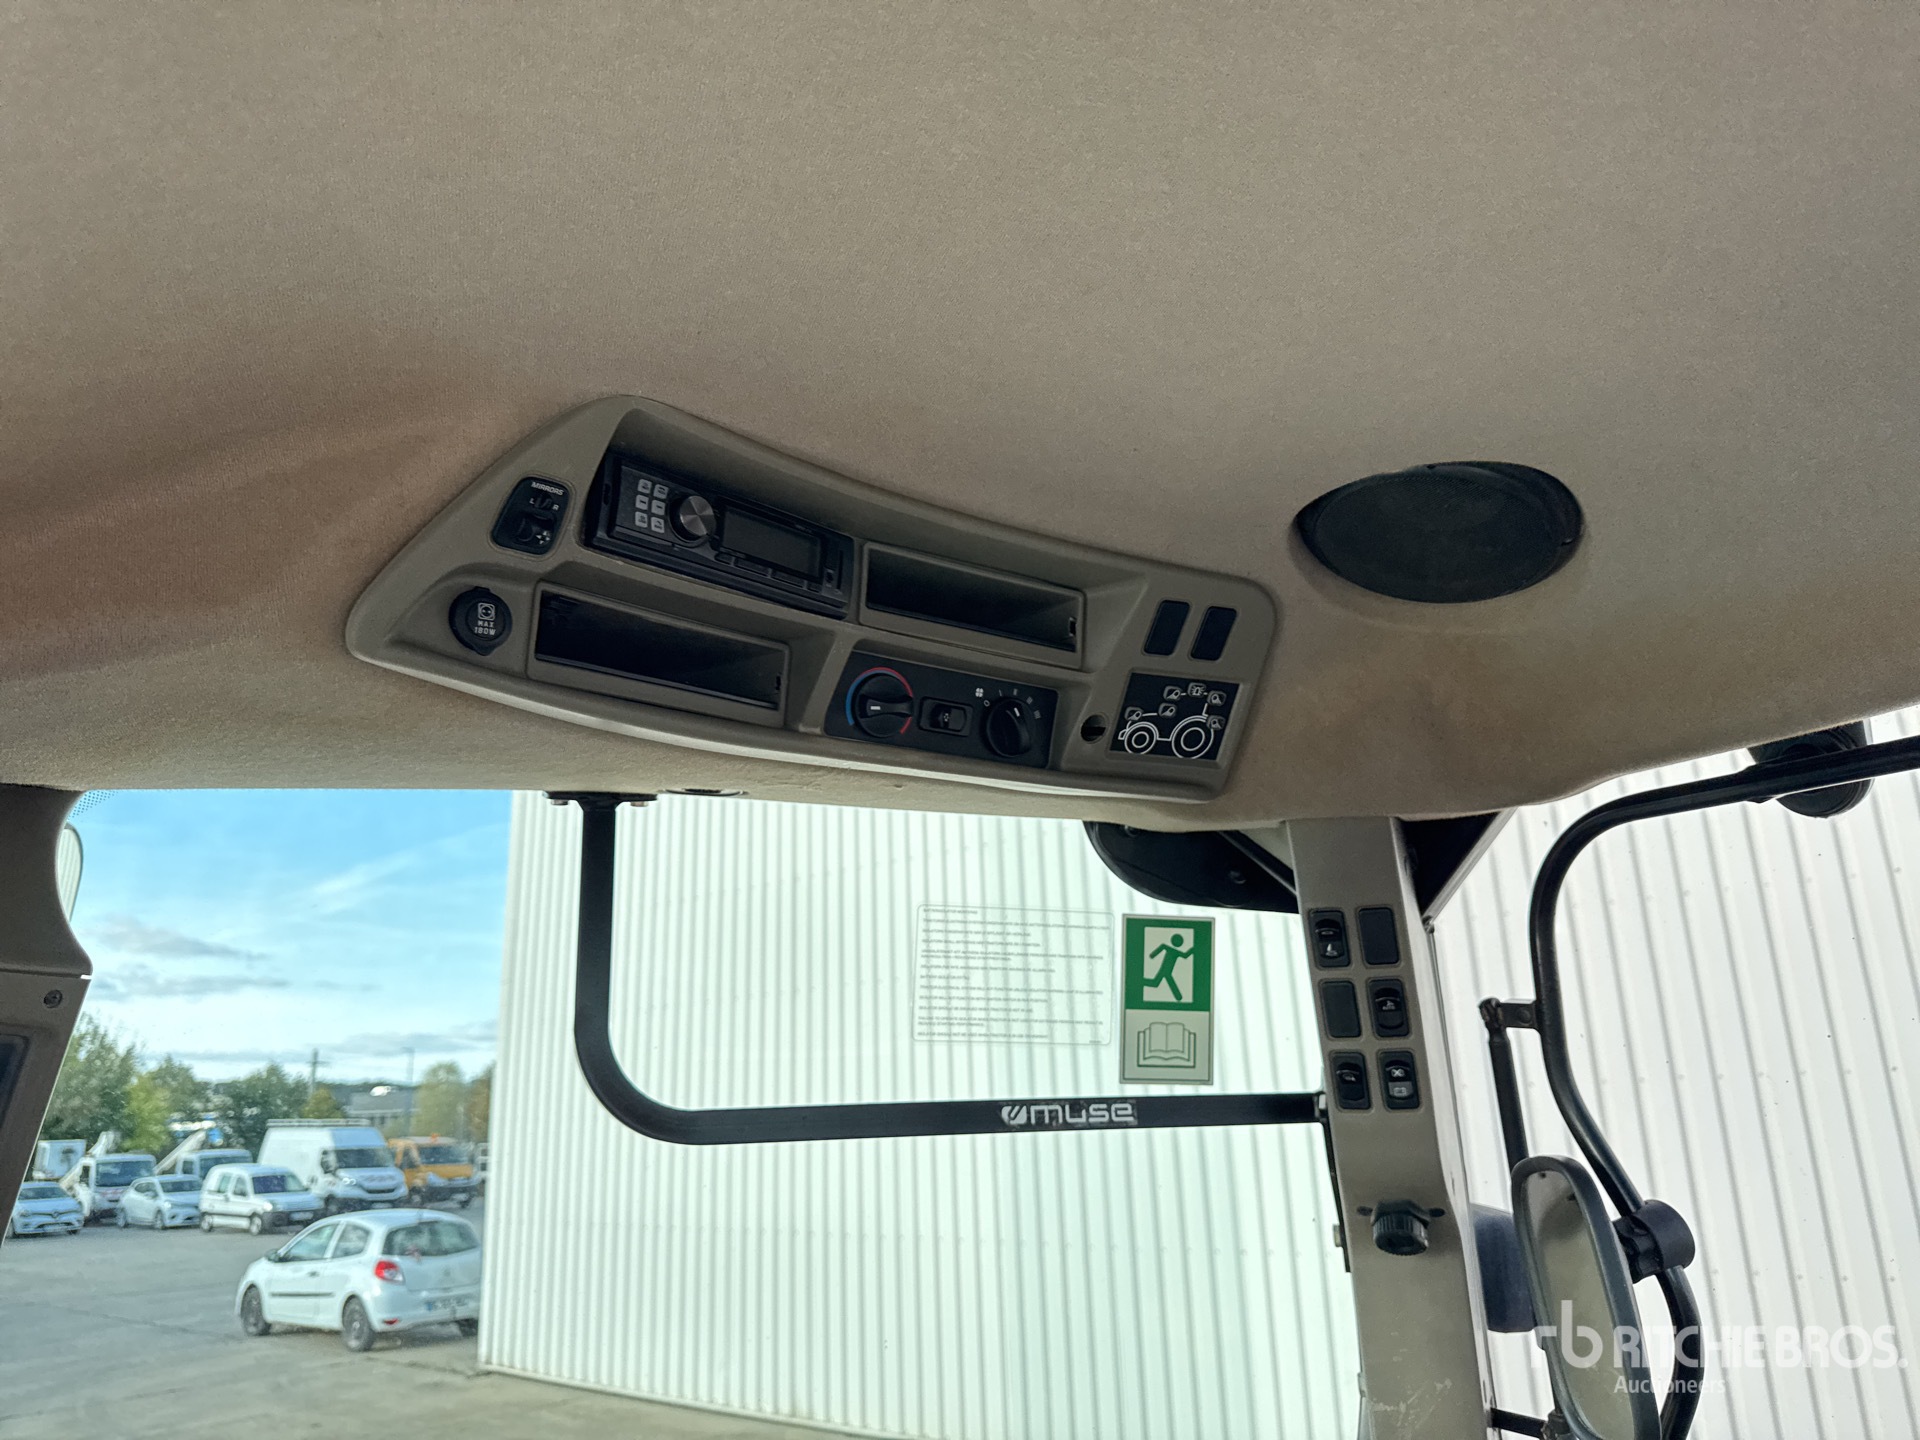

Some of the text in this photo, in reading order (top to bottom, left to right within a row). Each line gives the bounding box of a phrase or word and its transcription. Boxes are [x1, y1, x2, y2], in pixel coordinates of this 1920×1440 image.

[530, 481, 564, 496] MIRRORS
[477, 620, 495, 628] MAX
[474, 626, 496, 636] 180W
